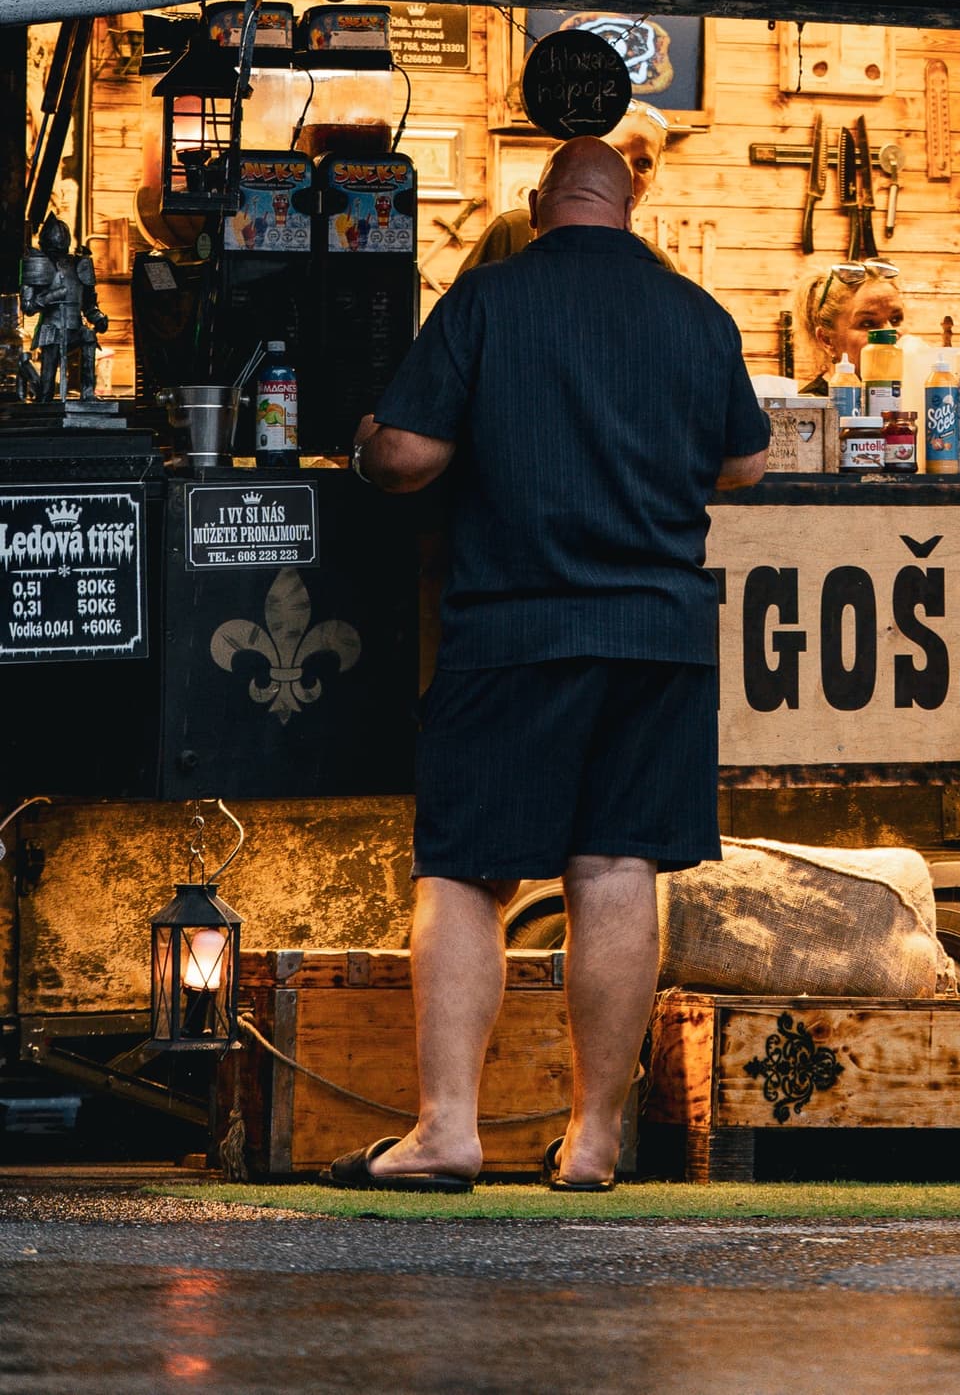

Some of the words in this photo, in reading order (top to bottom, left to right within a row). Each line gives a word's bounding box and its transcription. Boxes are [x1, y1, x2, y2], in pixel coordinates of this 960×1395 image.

[334, 163, 407, 183] SNEKY
[219, 508, 225, 524] I
[227, 507, 243, 524] VY
[246, 506, 259, 523] SI
[261, 500, 286, 523] NÁS
[193, 522, 238, 544] MŮŽETE
[240, 524, 312, 542] PRONAJMOUT.
[0, 522, 85, 566] Ledová
[208, 552, 235, 563] TEL.:
[238, 550, 256, 562] 608
[259, 550, 278, 561] 228
[280, 549, 298, 561] 223
[77, 579, 116, 597] 80Kč
[77, 598, 116, 616] 50Kč
[81, 619, 122, 637] +60Kč
